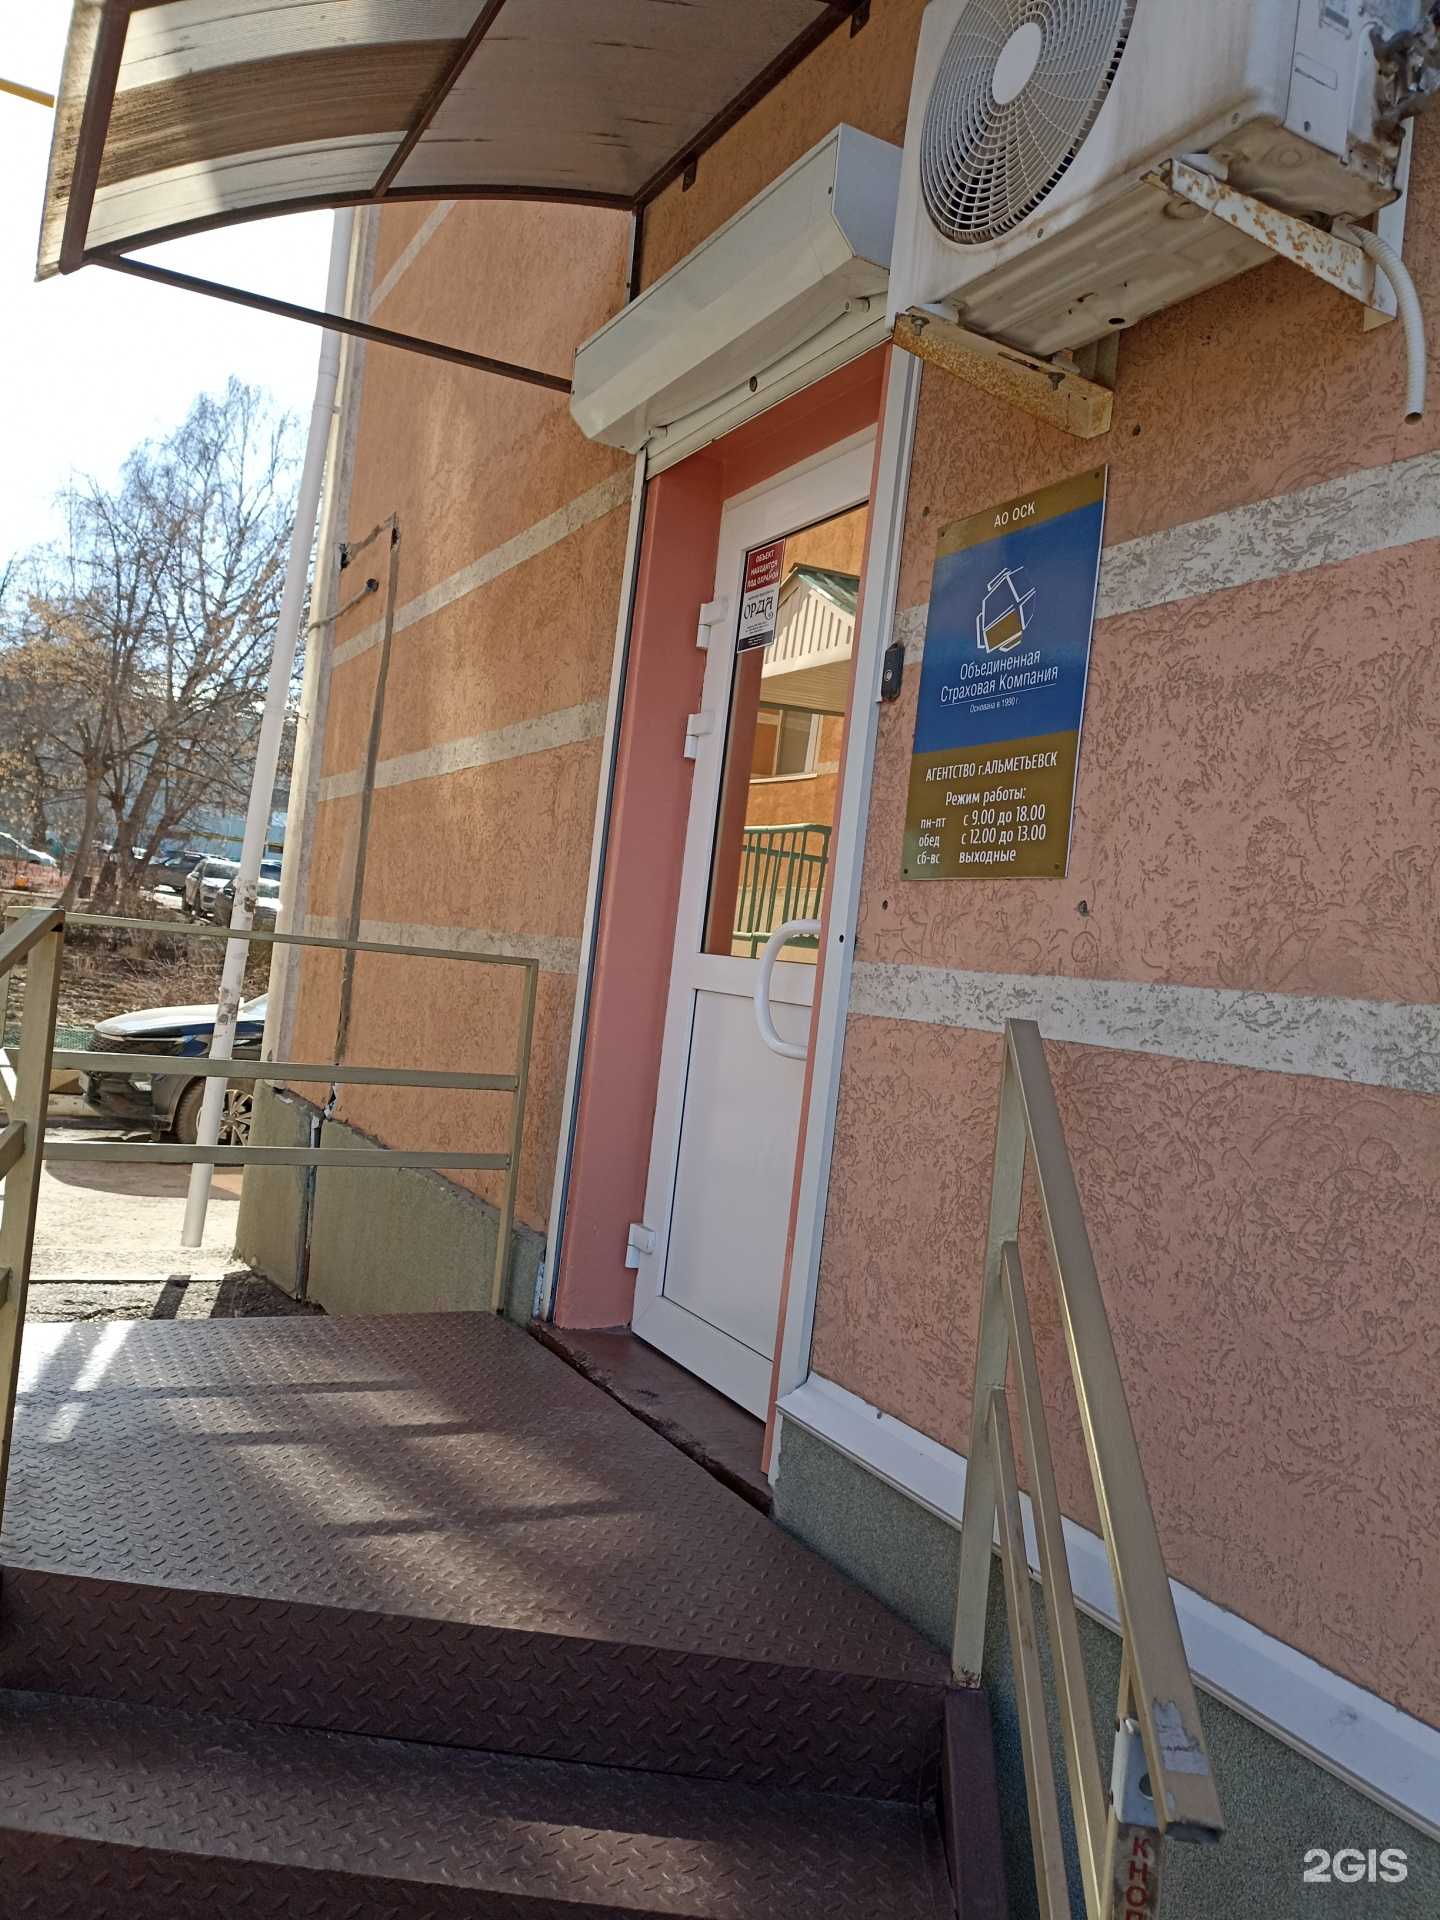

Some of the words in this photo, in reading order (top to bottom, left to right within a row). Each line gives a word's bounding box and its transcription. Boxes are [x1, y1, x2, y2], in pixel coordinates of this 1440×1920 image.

[994, 511, 1009, 528] АО
[1012, 501, 1036, 521] ОСК
[960, 650, 1041, 681] Объединенная
[940, 679, 996, 703] Страховая
[999, 666, 1059, 692] Компания
[925, 763, 976, 782] АГЕНТСТВО
[978, 751, 1058, 776] г.АЛЬМЕТЬЕВСК
[945, 791, 980, 807] Режим
[983, 786, 1027, 805] работы:
[920, 816, 946, 829] пн-пт
[963, 815, 969, 826] с
[971, 808, 995, 826] 9.00
[997, 811, 1012, 826] до
[1016, 804, 1046, 823] 18.00
[918, 834, 940, 848] обед
[961, 834, 967, 845] с
[969, 827, 996, 844] 12.00
[998, 830, 1014, 846] до
[1017, 823, 1047, 842] 13.00
[917, 851, 940, 865] сб-вс
[959, 849, 1017, 865] выходные
